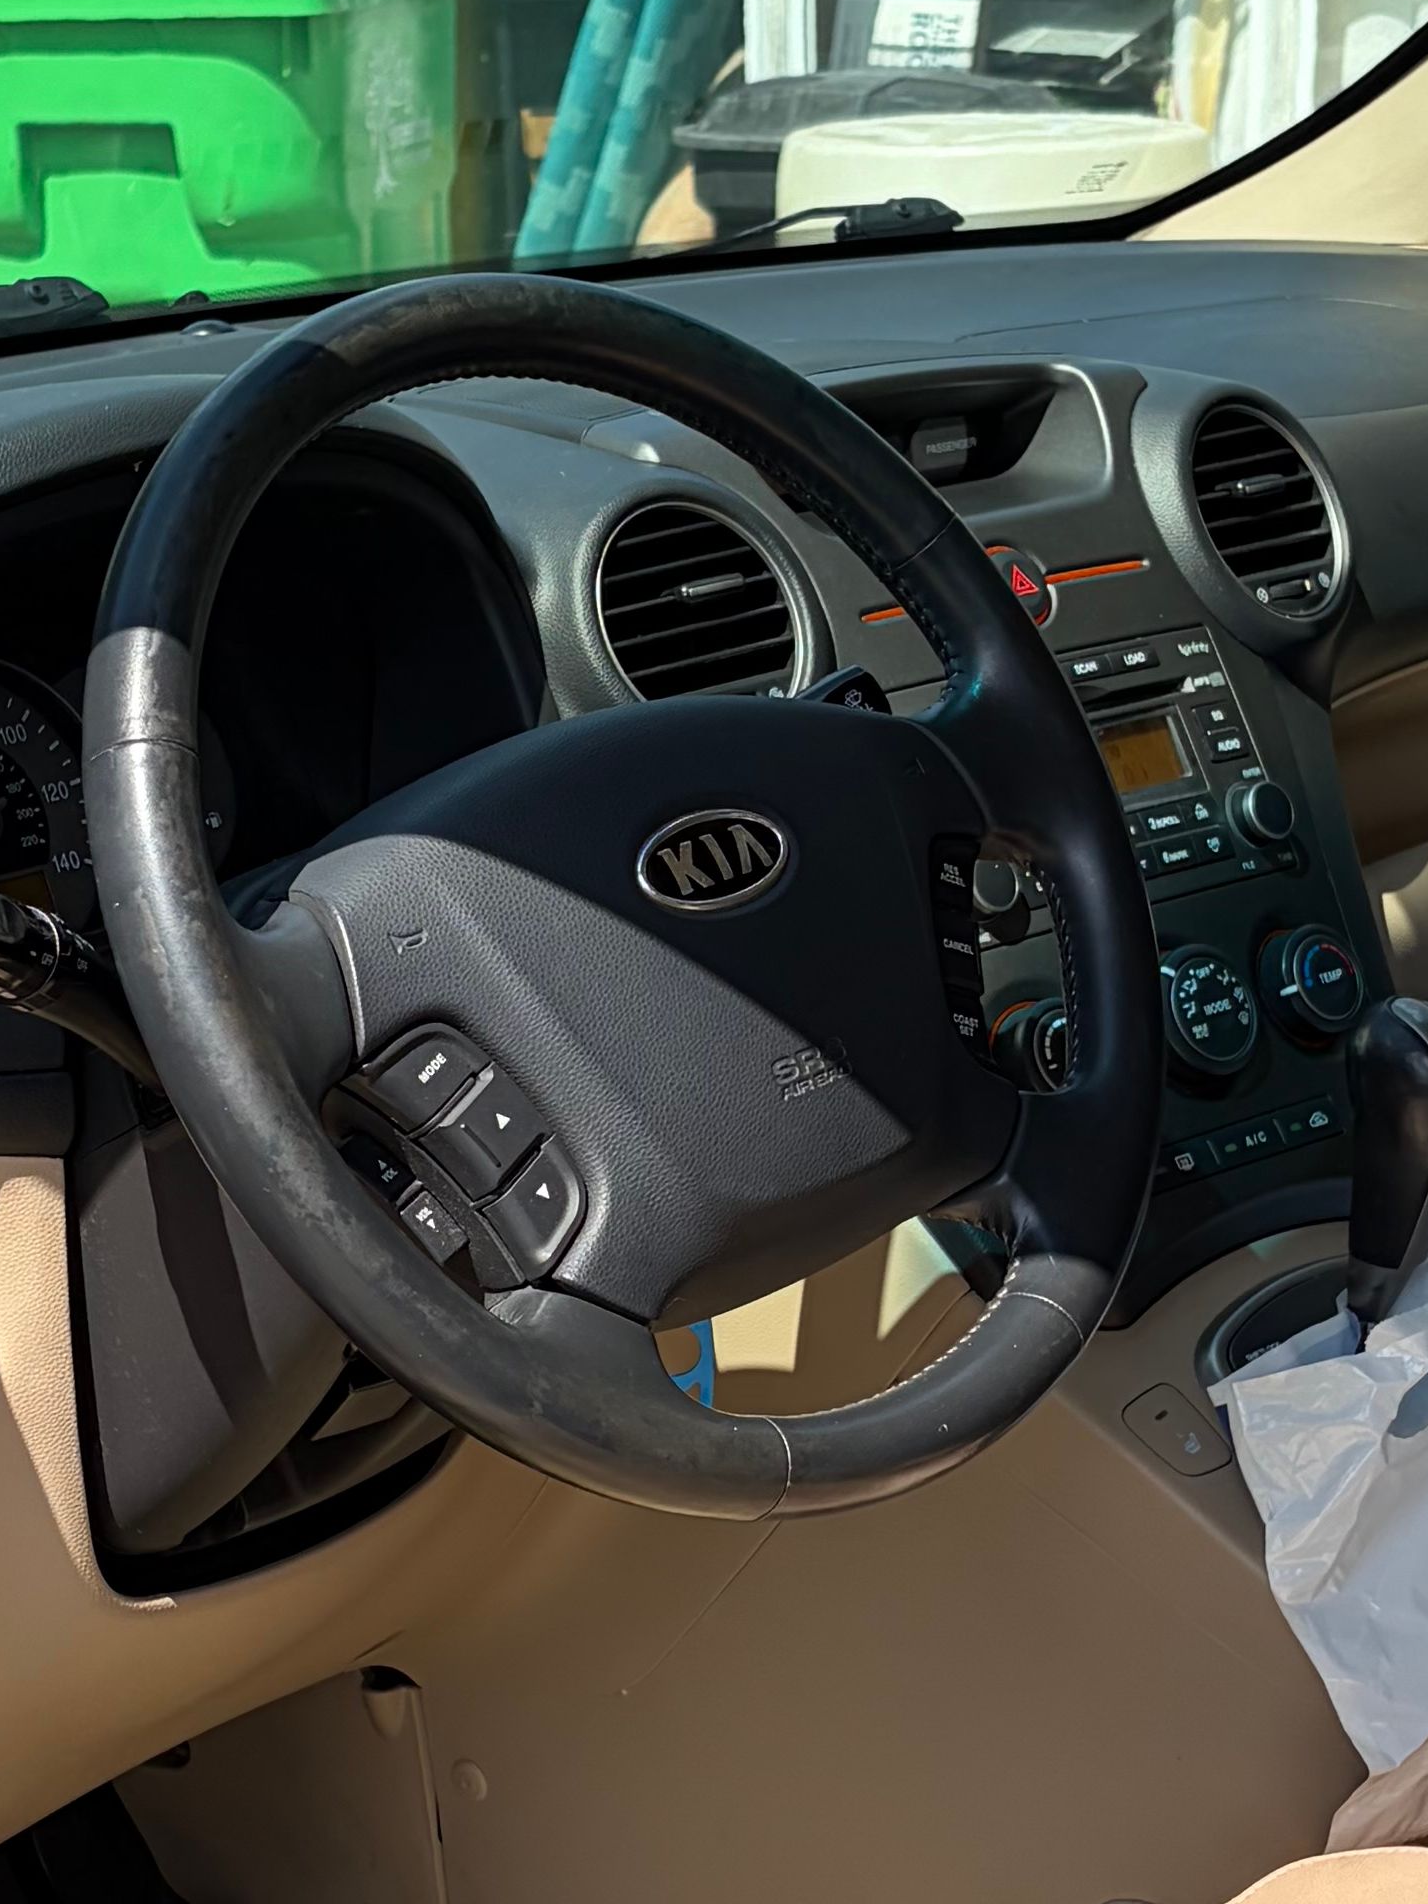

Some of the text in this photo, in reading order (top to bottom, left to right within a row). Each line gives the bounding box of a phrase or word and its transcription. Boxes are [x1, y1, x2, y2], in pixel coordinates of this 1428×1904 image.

[41, 780, 69, 803] 120
[20, 834, 39, 847] 220
[52, 850, 81, 873] 140
[656, 824, 774, 896] KIA
[943, 862, 960, 876] RES
[940, 872, 967, 888] ACCEL
[943, 937, 975, 956] CANCEL
[1318, 967, 1343, 985] TEMP
[1203, 998, 1233, 1016] MODE
[953, 1012, 980, 1029] COAST
[418, 1052, 447, 1084] MODE
[1244, 1130, 1268, 1147] A/C
